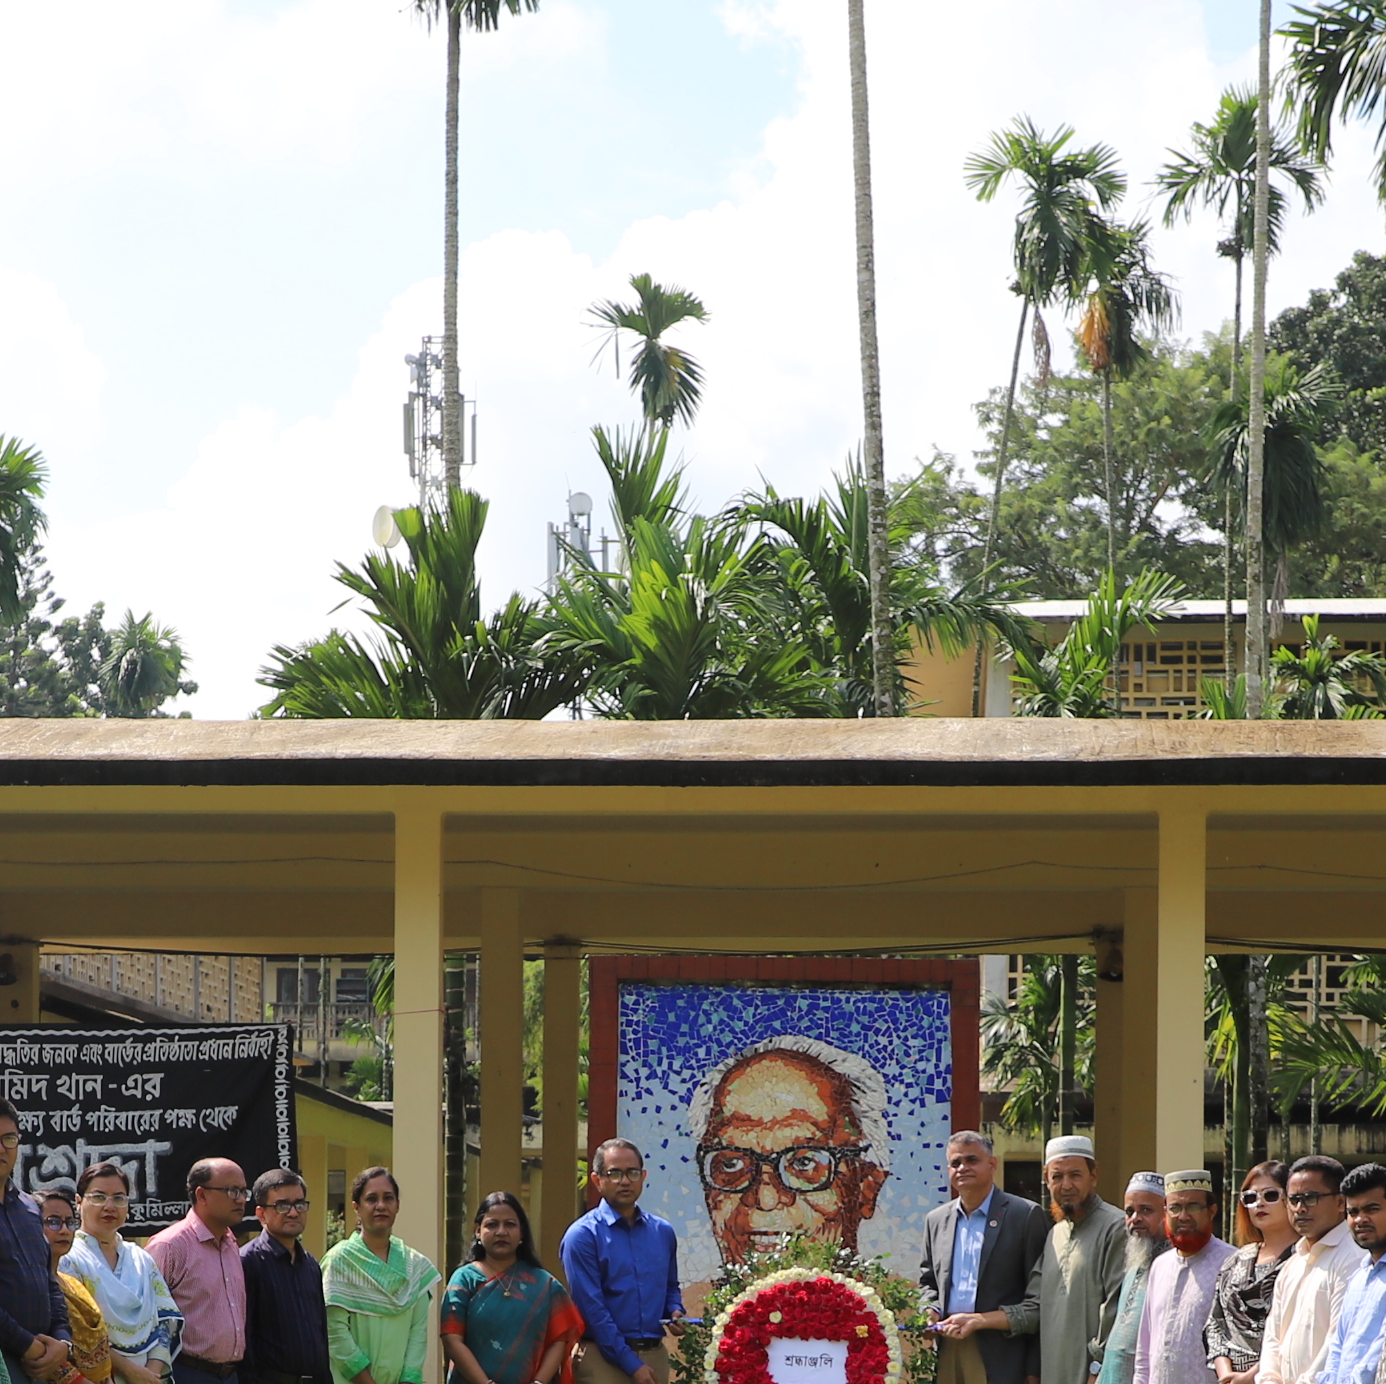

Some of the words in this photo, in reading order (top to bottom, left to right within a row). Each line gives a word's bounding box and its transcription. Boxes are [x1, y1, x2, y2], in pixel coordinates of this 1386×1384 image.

[42, 1043, 79, 1067] জনক
[80, 1044, 103, 1065] এবং
[104, 1037, 143, 1067] বার্ডের
[143, 1035, 199, 1062] প্রতিষ্ঠাতা
[198, 1038, 234, 1060] প্রধান
[234, 1030, 275, 1060] নির্বাহী
[49, 1103, 82, 1132] বার্ড
[85, 1105, 163, 1136] পরিবারের
[164, 1109, 196, 1129] পক্ষ
[199, 1105, 239, 1133] থেকে
[784, 1353, 834, 1368] শ্রদ্ধাঞ্জলি
